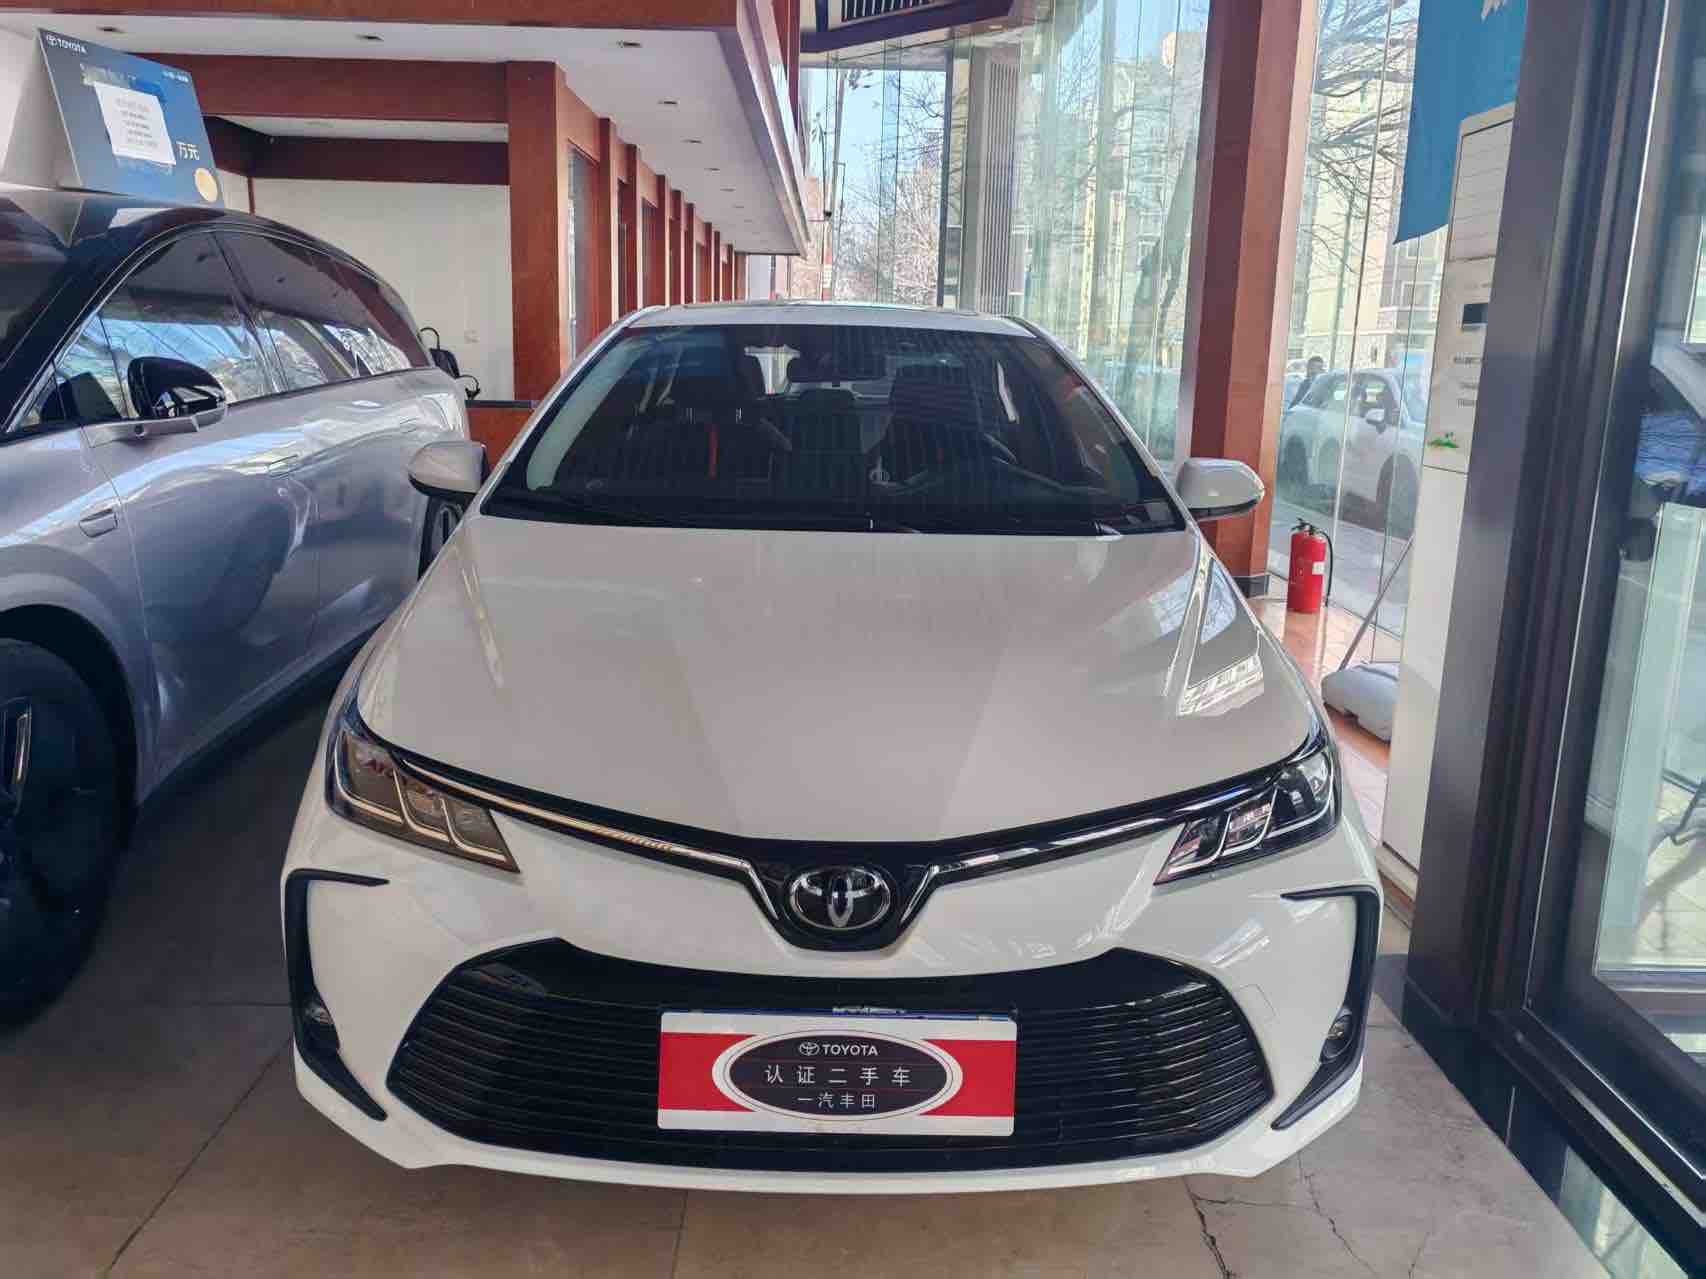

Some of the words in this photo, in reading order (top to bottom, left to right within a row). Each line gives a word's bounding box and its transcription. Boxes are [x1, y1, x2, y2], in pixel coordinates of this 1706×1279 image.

[57, 38, 87, 54] TOYOTA
[176, 141, 200, 161] 万元
[822, 1043, 879, 1056] TOYOTA
[765, 1064, 911, 1087] 认证二手车
[797, 1091, 876, 1109] 一汽丰田
